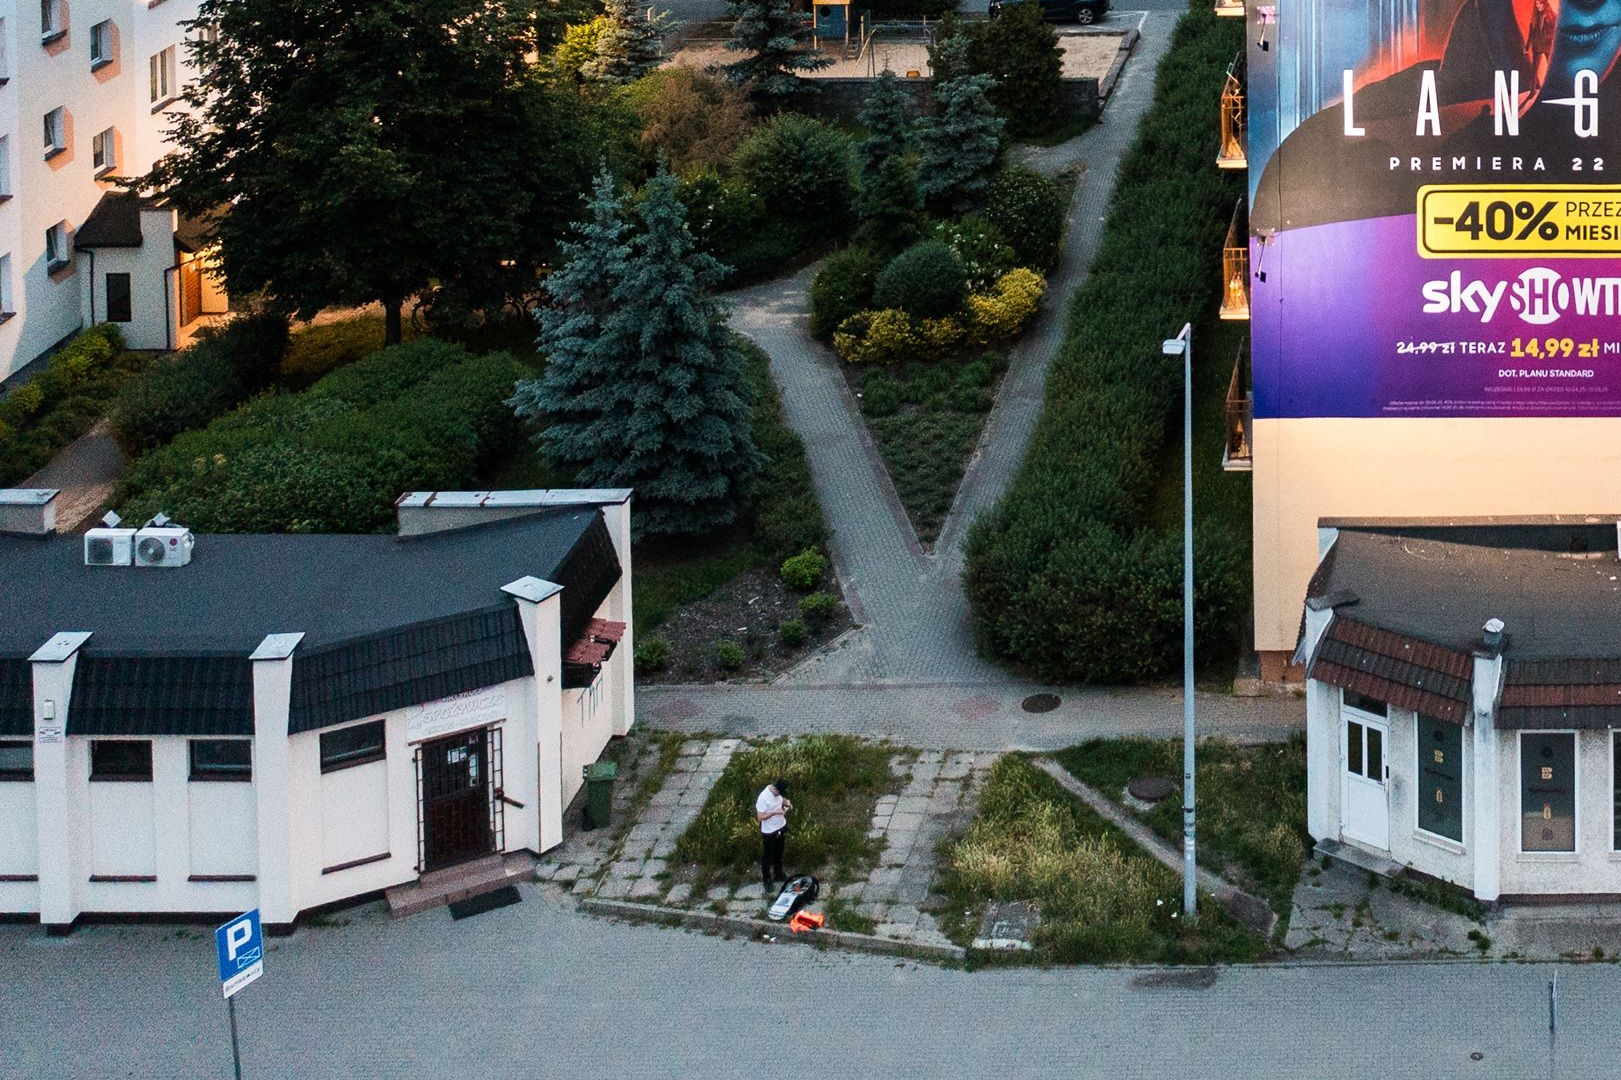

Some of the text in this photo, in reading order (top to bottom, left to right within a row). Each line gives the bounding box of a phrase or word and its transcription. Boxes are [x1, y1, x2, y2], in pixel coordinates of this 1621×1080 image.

[1389, 156, 1546, 171] PREMIERA
[1571, 157, 1605, 171] 22
[1433, 201, 1559, 241] -40%
[1396, 341, 1439, 355] 24,99
[1460, 341, 1506, 354] TERAZ
[1510, 338, 1574, 359] 14,99
[1578, 338, 1600, 357] zł
[1498, 369, 1595, 378] DOT. PLANU STANDARD
[227, 918, 253, 961] P
